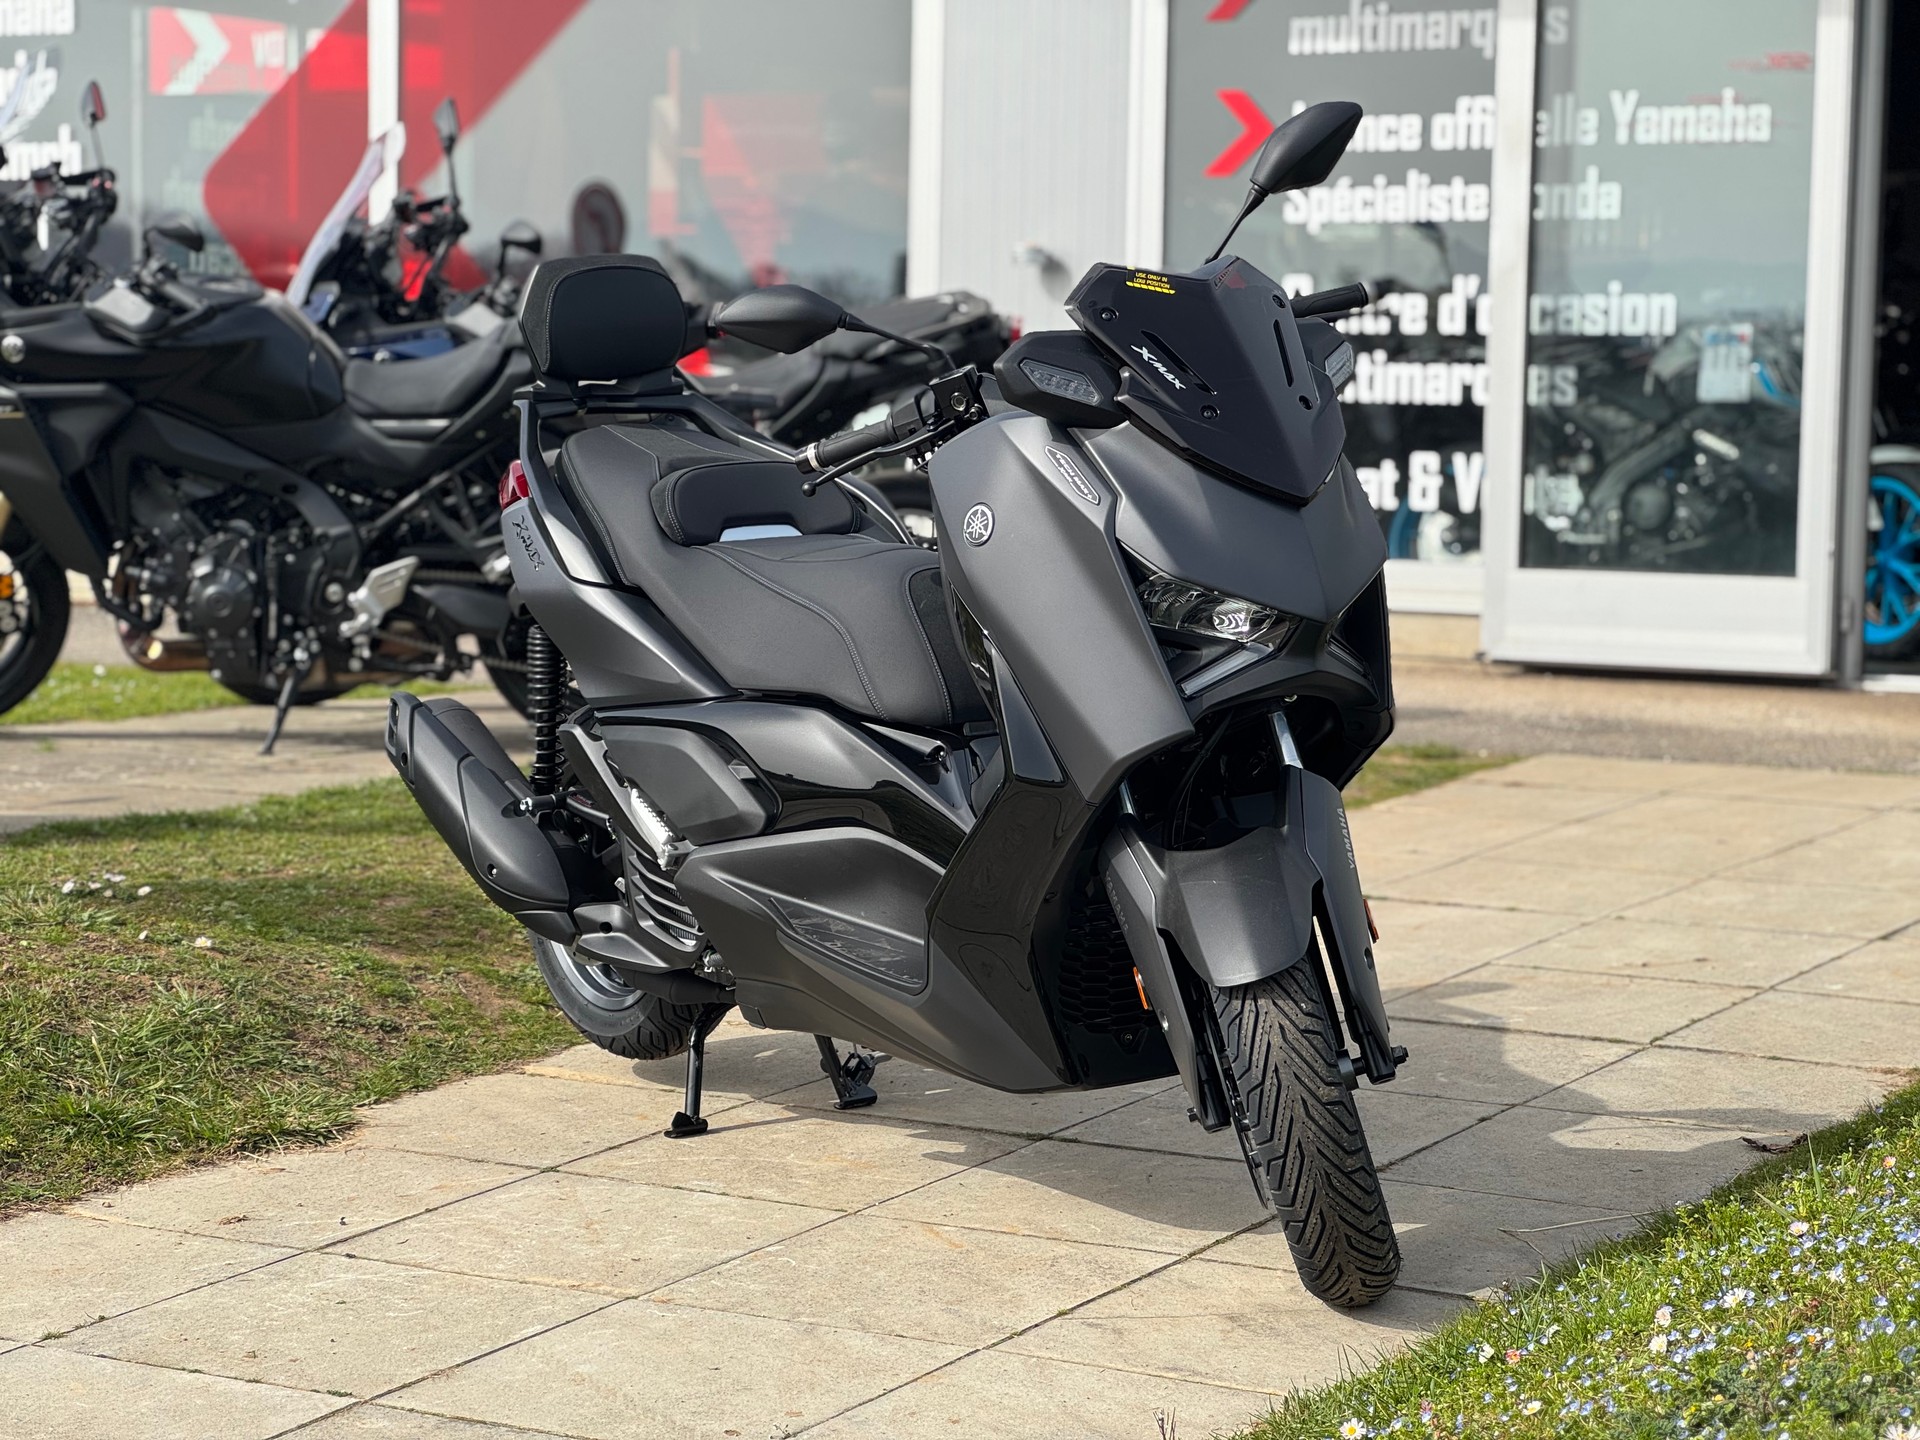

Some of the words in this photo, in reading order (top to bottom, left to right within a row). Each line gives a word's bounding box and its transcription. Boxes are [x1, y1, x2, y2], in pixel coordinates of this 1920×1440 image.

[1287, 0, 1569, 60] multimarqs
[1609, 87, 1772, 145] Yamaha
[1282, 168, 1490, 236] Spécialiste
[1146, 279, 1170, 289] POSITION
[1147, 273, 1161, 281] ONLY
[1130, 344, 1187, 390] XMAX
[1055, 453, 1075, 476] TECH
[1407, 450, 1444, 513] &
[1336, 807, 1356, 869] YAMAHA
